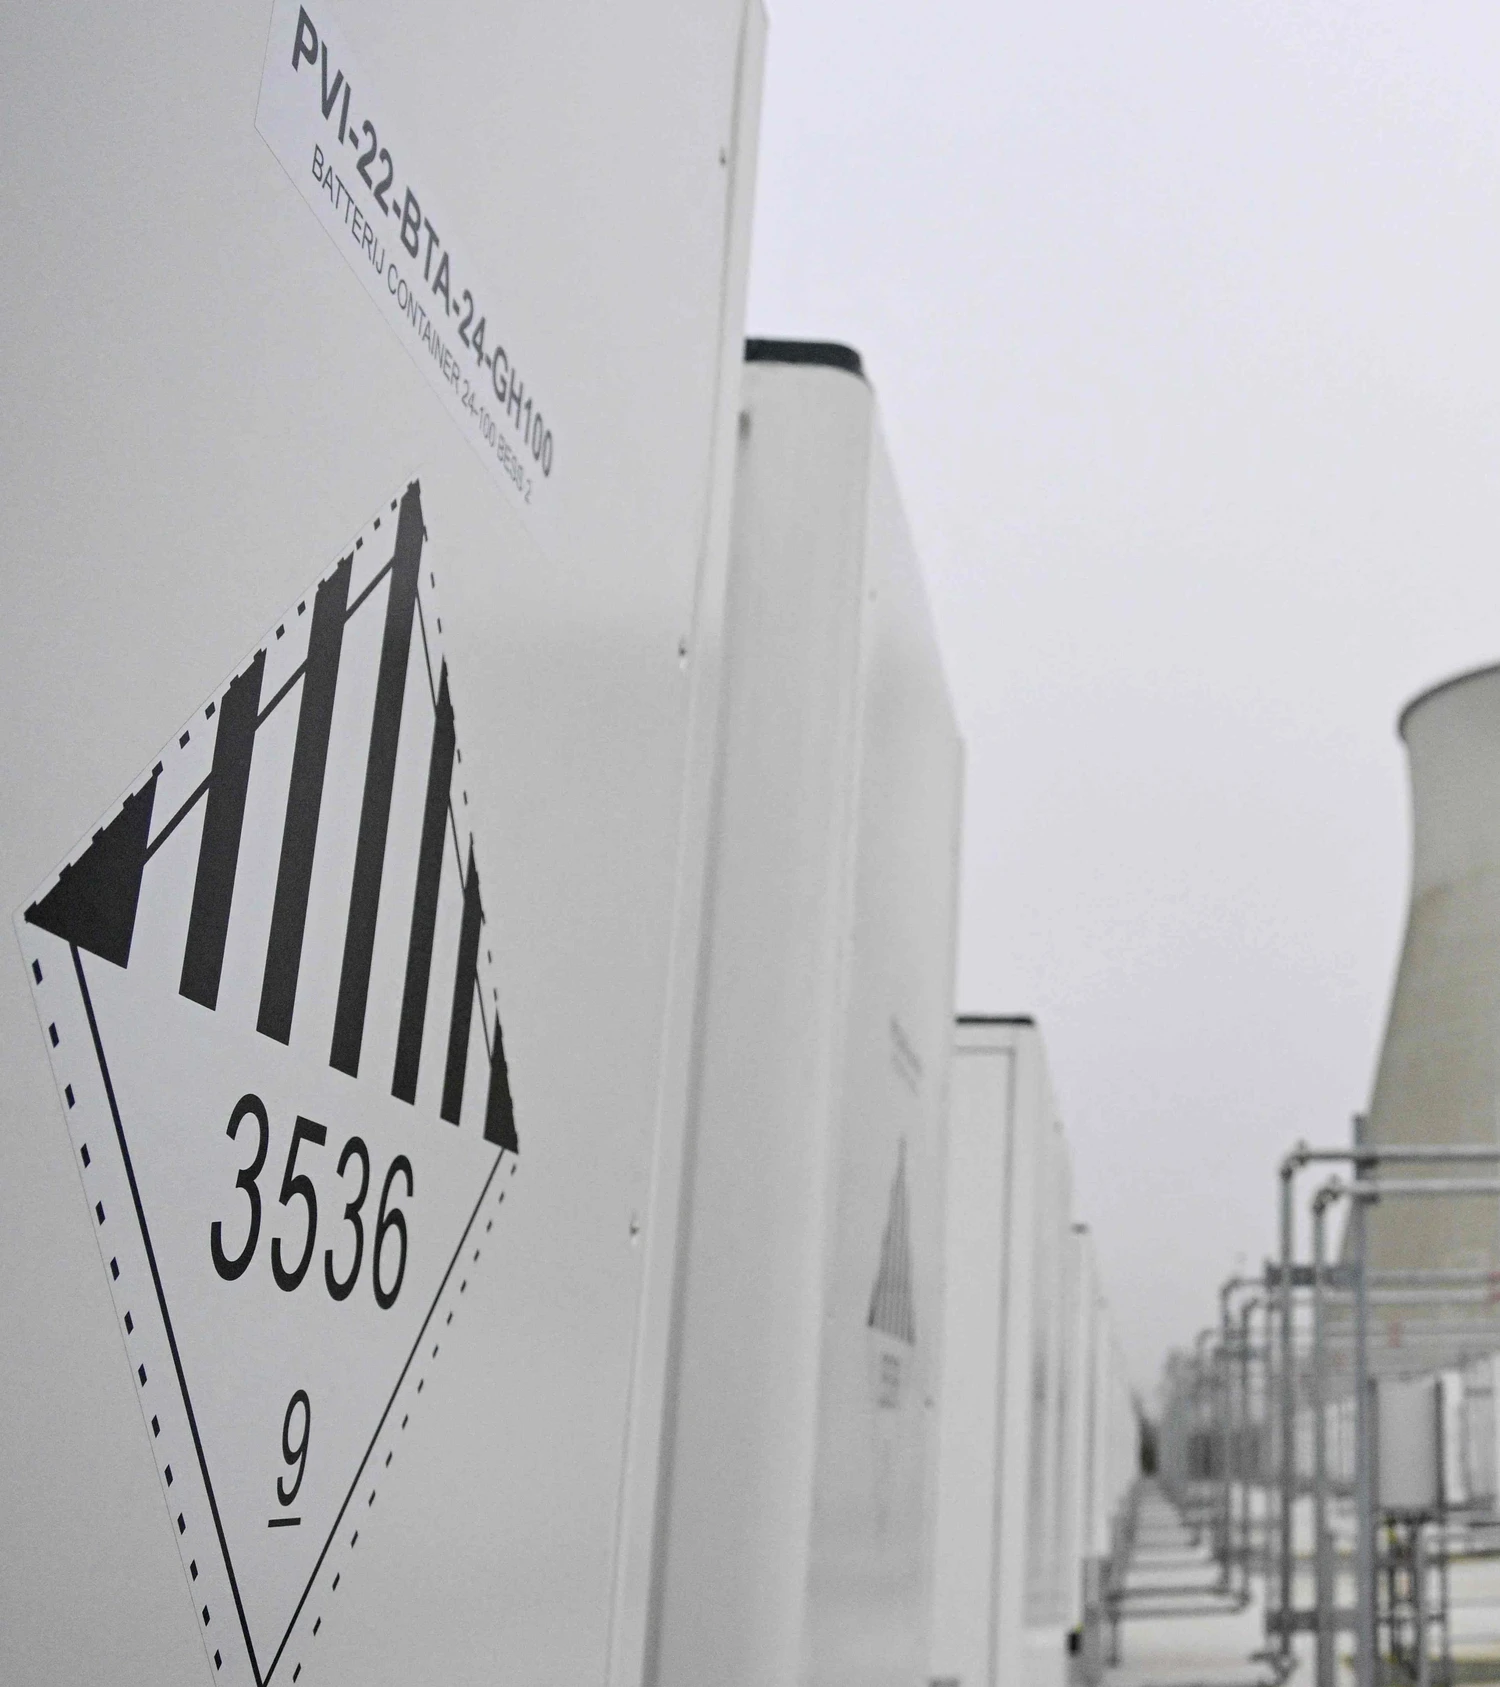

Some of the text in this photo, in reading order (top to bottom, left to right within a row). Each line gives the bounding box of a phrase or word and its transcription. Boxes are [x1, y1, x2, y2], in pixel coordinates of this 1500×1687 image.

[292, 4, 552, 478] PVI-22-BTA-24-GH100
[312, 144, 385, 275] BATTERIJ
[387, 263, 461, 394] CONTAINER
[210, 1094, 414, 1310] 3536
[276, 1389, 311, 1507] 9
